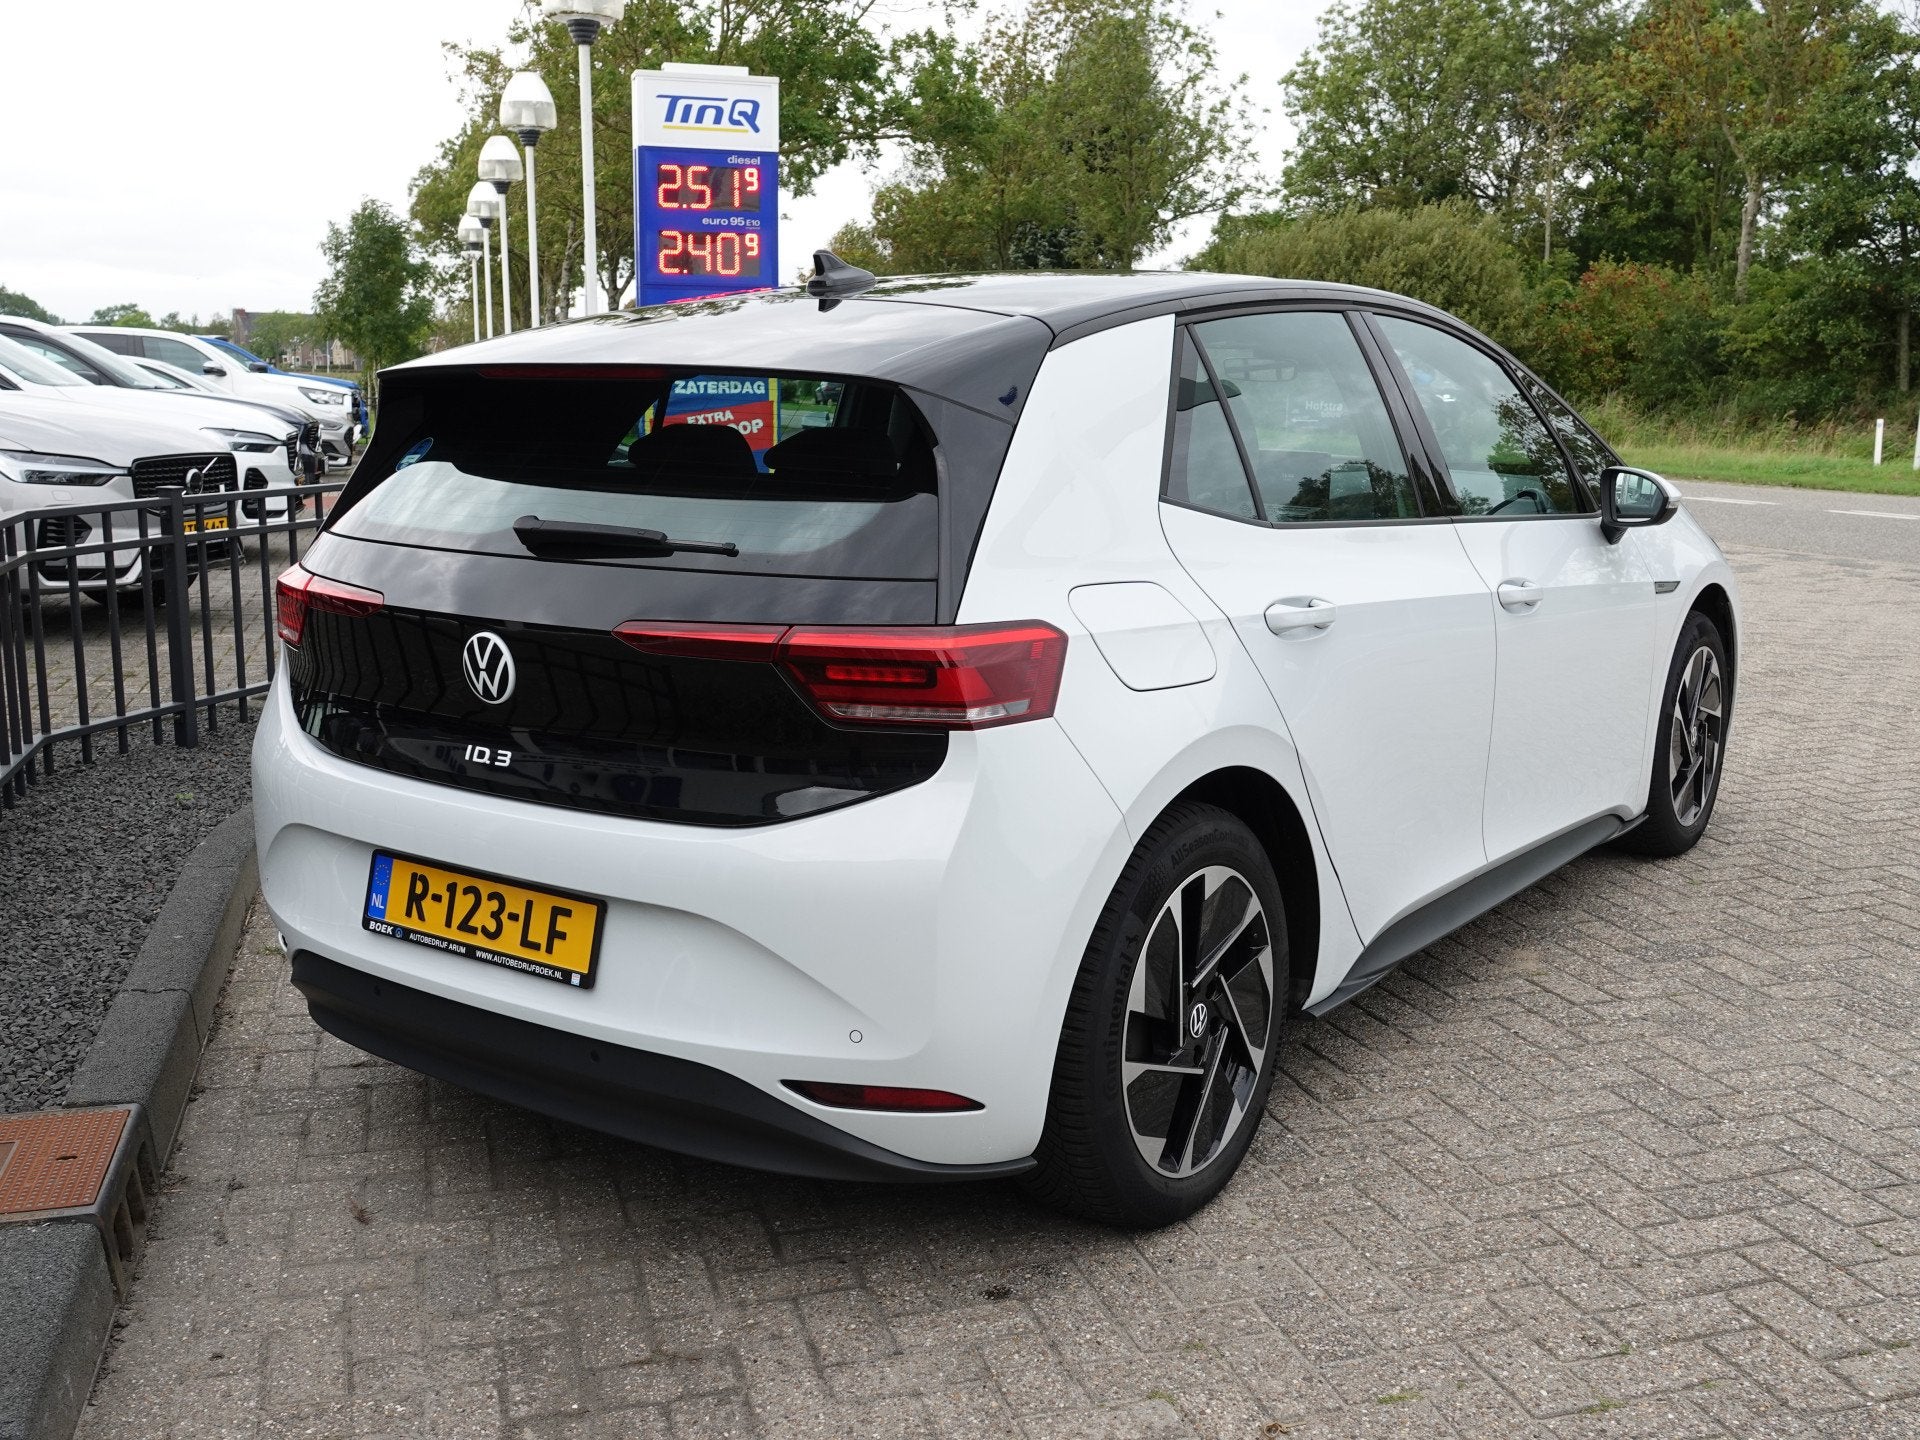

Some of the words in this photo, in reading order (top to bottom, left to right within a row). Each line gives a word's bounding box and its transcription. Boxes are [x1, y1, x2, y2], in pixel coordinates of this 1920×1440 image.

[727, 155, 761, 166] diesel
[701, 217, 729, 227] euro
[730, 216, 745, 227] 95
[746, 219, 761, 227] E10
[673, 380, 766, 395] ZATERDAG
[1305, 400, 1343, 411] Hofstra
[686, 409, 734, 426] EXTRA
[371, 893, 385, 910] NL
[404, 871, 573, 955] R-123-LF
[369, 920, 394, 935] BOEK
[409, 932, 449, 950] AUTOBEDRIJF
[448, 942, 466, 954] ARUM
[475, 949, 563, 980] WWW.AUTOBEDRIJFBOEK.NL
